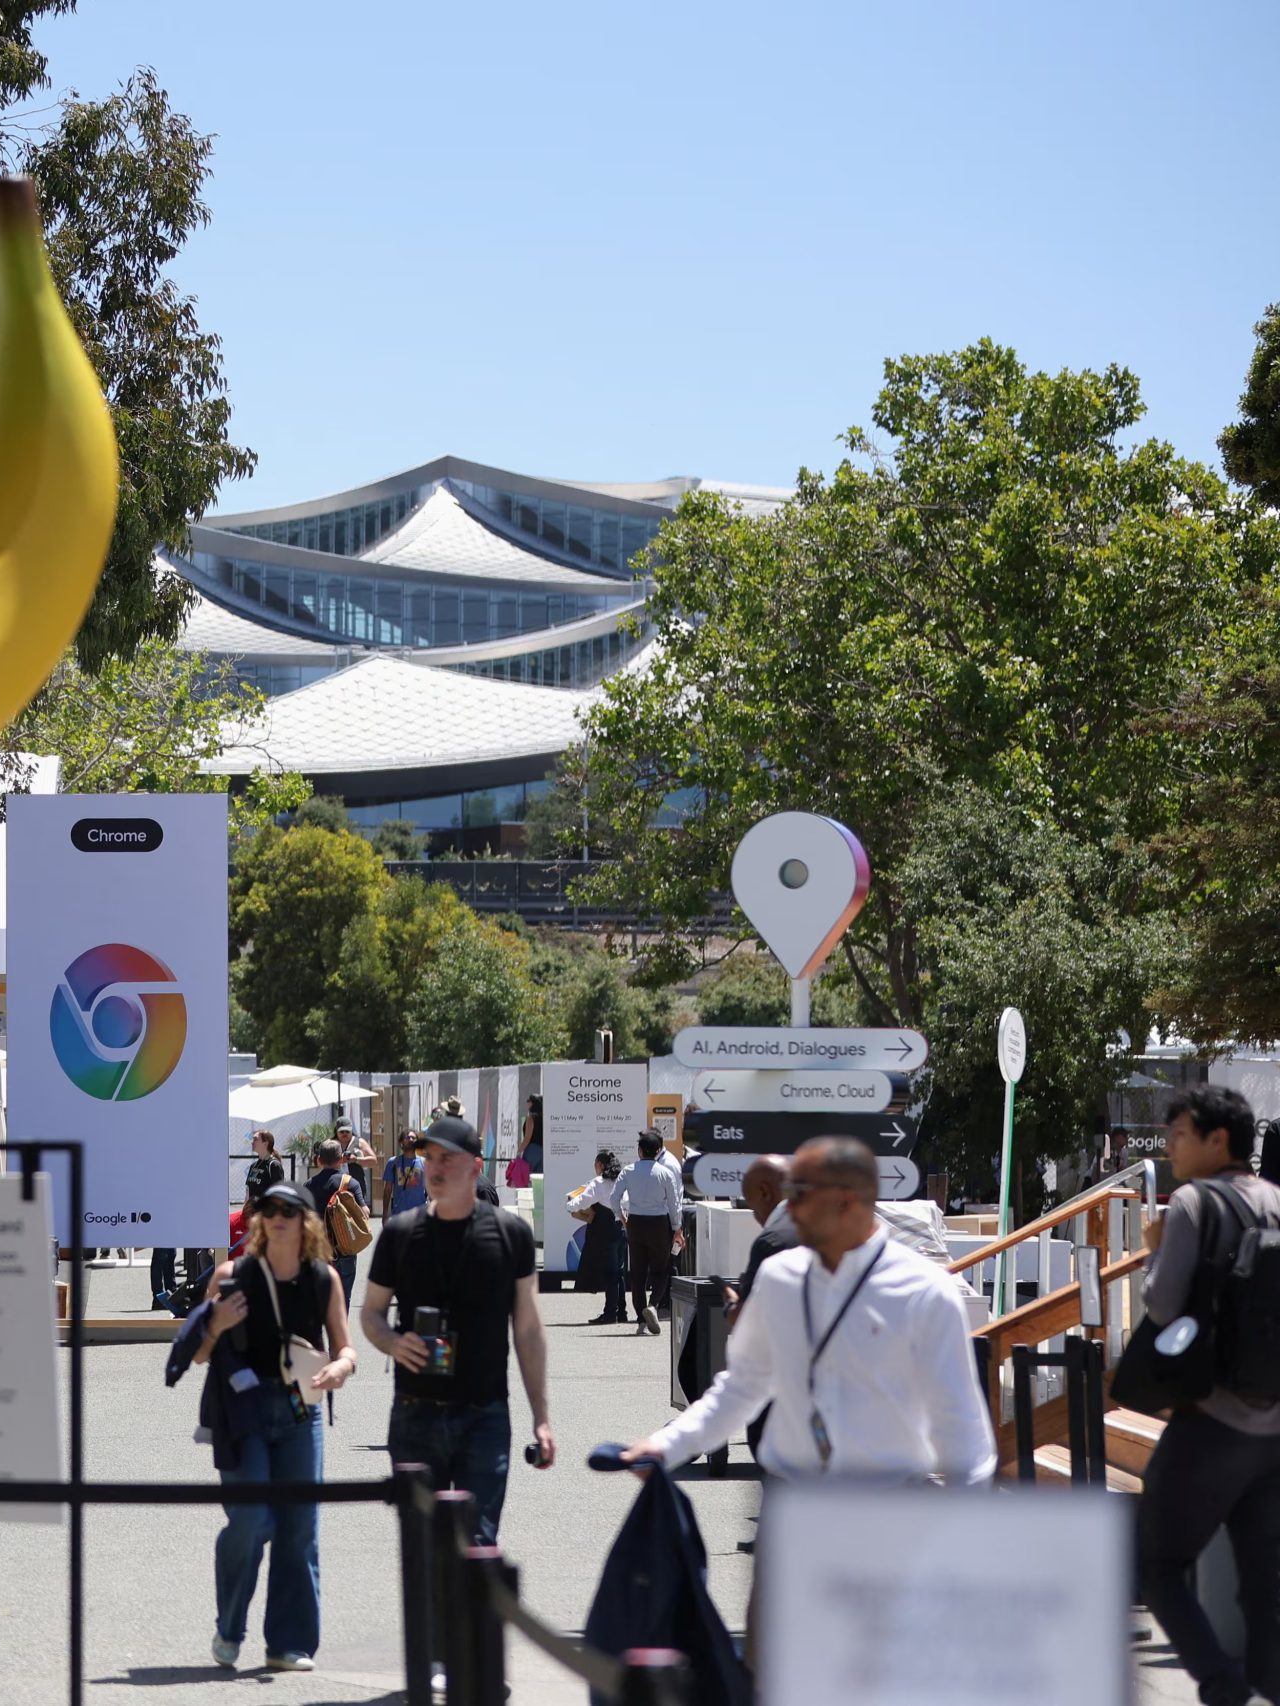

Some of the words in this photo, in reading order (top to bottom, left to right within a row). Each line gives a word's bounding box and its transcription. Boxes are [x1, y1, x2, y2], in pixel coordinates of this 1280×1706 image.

[87, 828, 147, 842] Chrome
[692, 1041, 713, 1056] AI,
[716, 1041, 784, 1056] Android,
[788, 1041, 866, 1060] Dialogues
[569, 1076, 622, 1088] Chrome
[567, 1090, 623, 1102] Sessions
[780, 1083, 835, 1099] Chrome,
[837, 1083, 875, 1098] Cloud
[713, 1125, 744, 1140] Eats
[1127, 1134, 1167, 1151] oogle
[710, 1168, 743, 1182] Rest
[84, 1211, 127, 1227] Google
